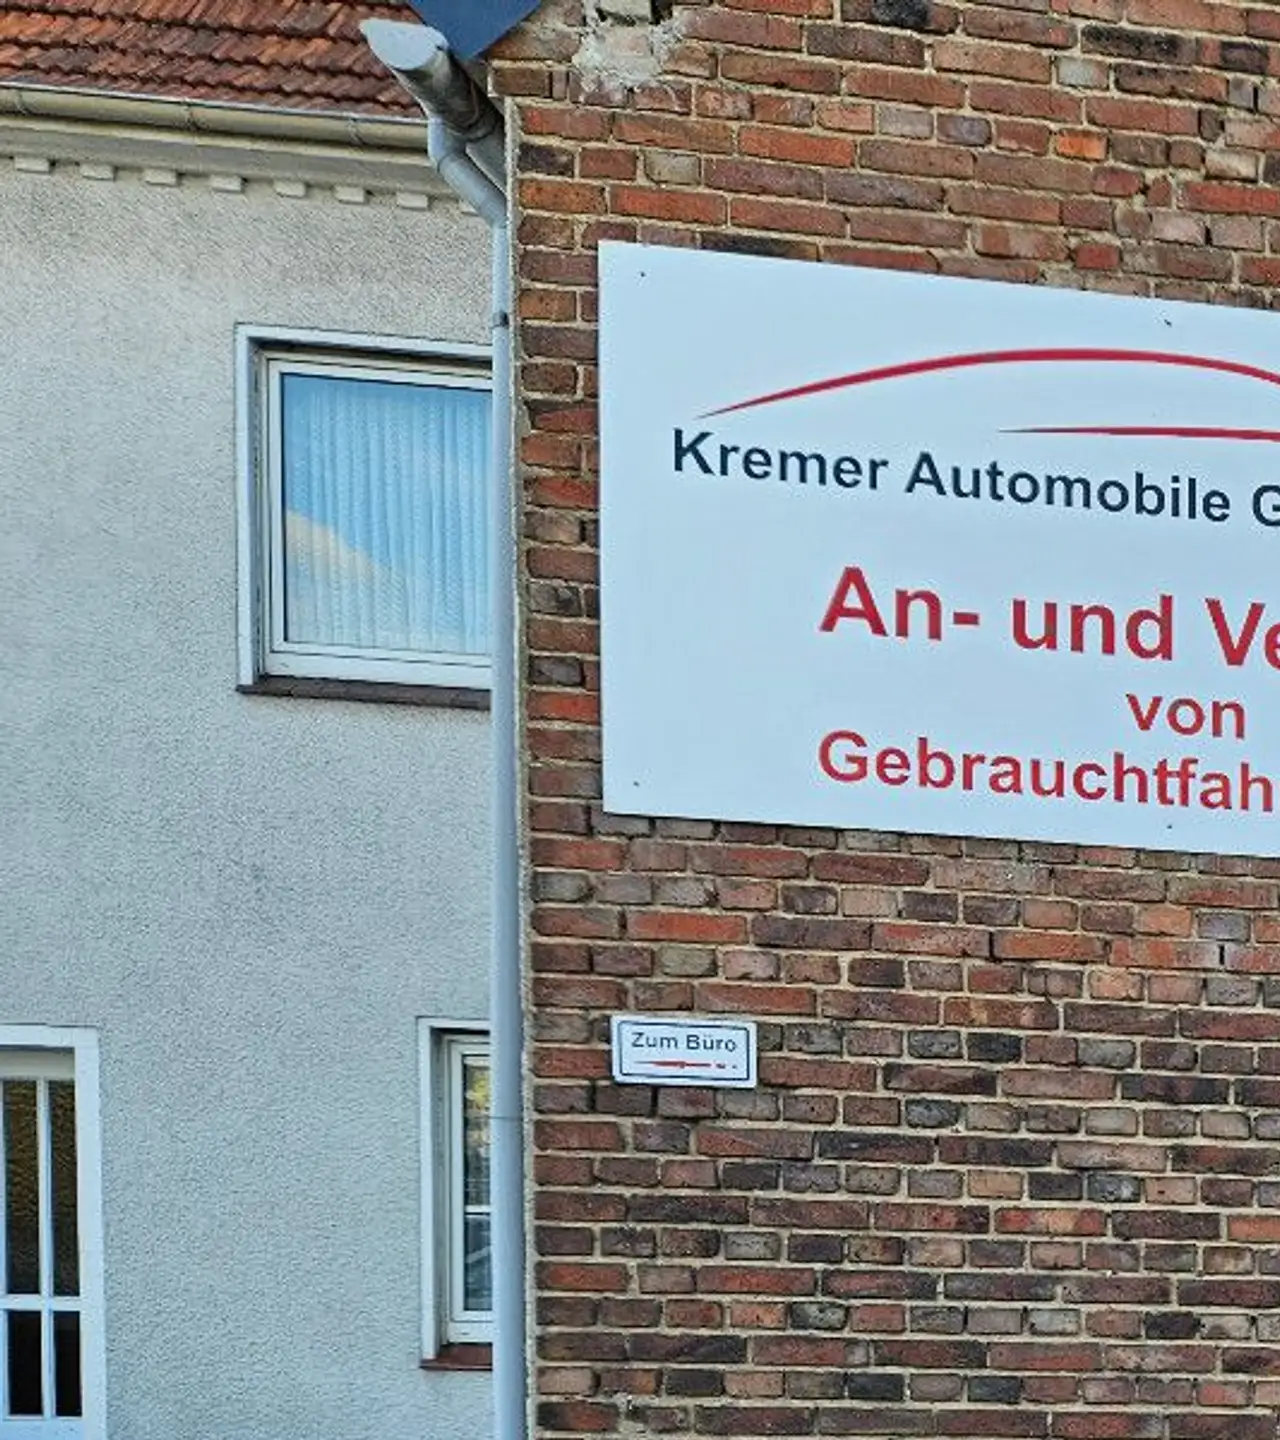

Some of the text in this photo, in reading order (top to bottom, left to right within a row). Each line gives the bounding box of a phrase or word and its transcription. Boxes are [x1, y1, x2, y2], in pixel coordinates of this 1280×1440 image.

[673, 427, 890, 491] Kremer
[904, 451, 1231, 523] Automobile
[819, 566, 981, 642] An-
[1012, 593, 1174, 662] und
[1125, 693, 1246, 740] von
[631, 1032, 738, 1052] Zum Büro
